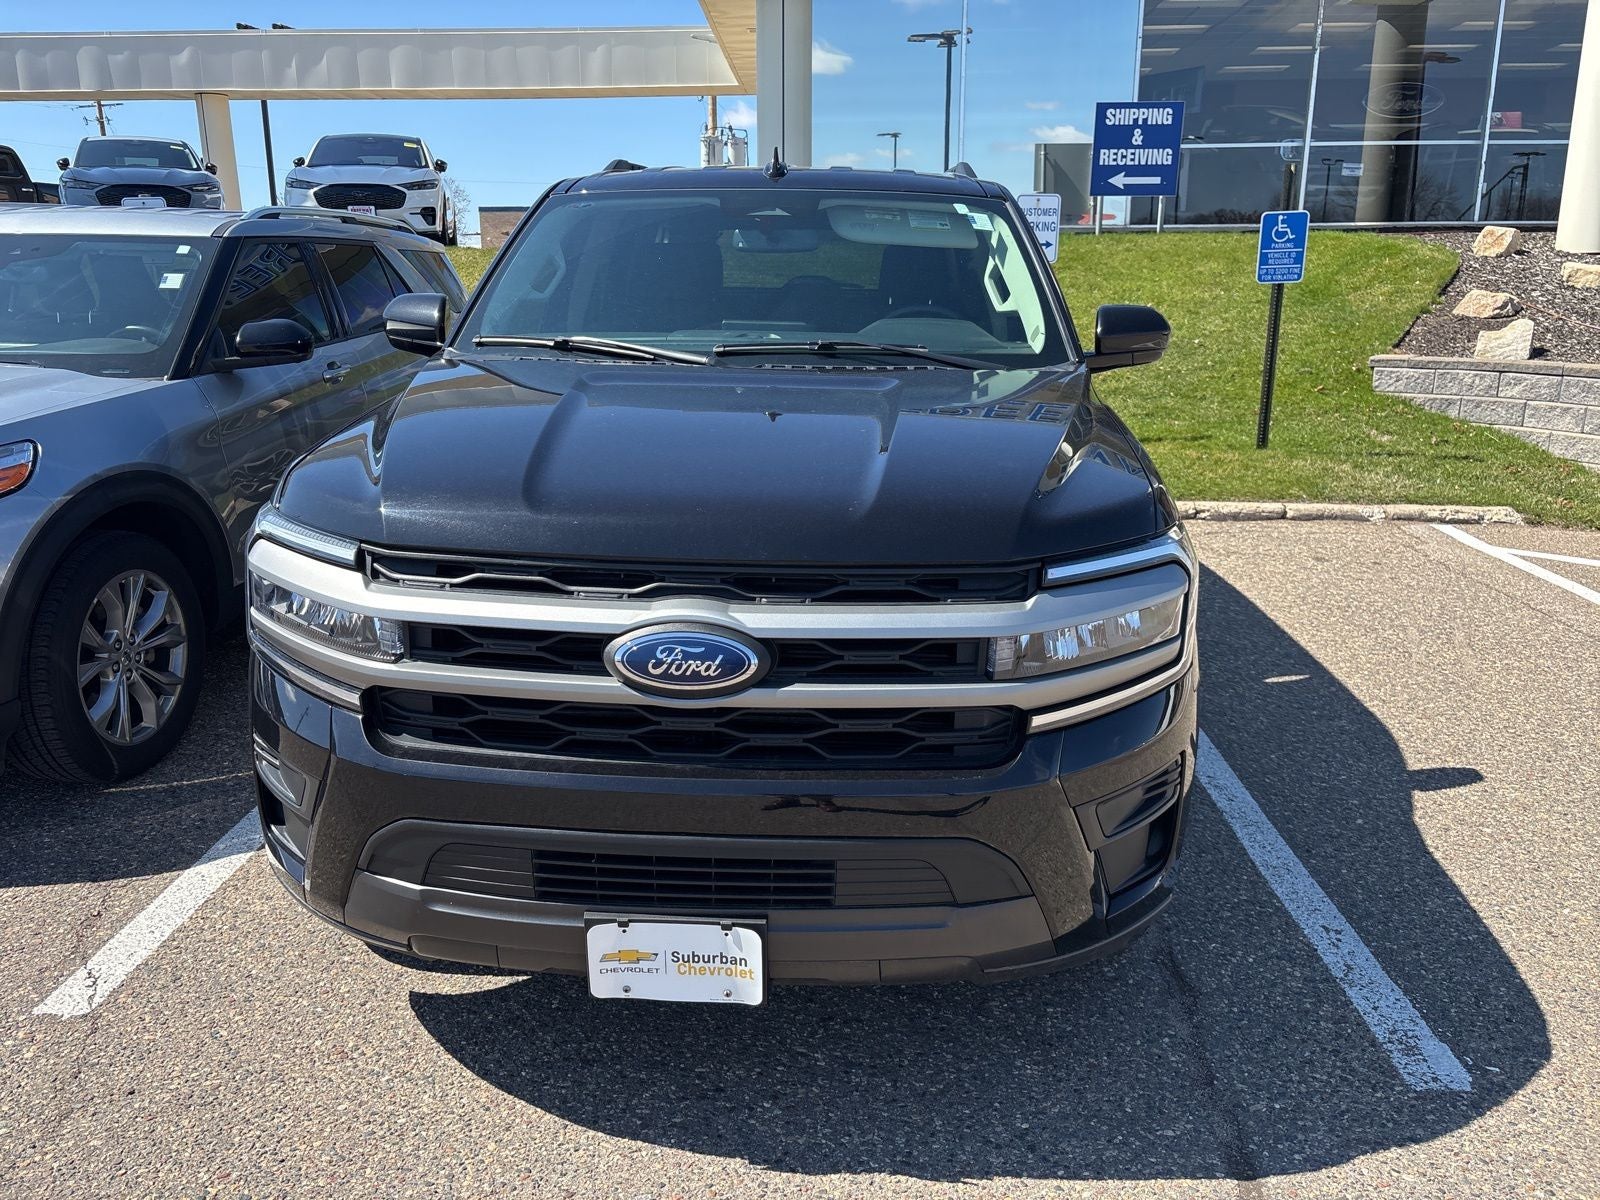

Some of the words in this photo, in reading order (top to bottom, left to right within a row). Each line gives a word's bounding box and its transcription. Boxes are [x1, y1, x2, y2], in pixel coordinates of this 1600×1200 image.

[1105, 108, 1173, 125] SHIPPING
[1131, 128, 1144, 145] &
[1099, 148, 1173, 165] RECEIVING
[1022, 207, 1058, 217] USTOMER
[647, 644, 724, 677] Ford
[671, 951, 748, 968] Suburban
[599, 966, 661, 975] CHEVROLET
[677, 962, 755, 981] Chevrolet
